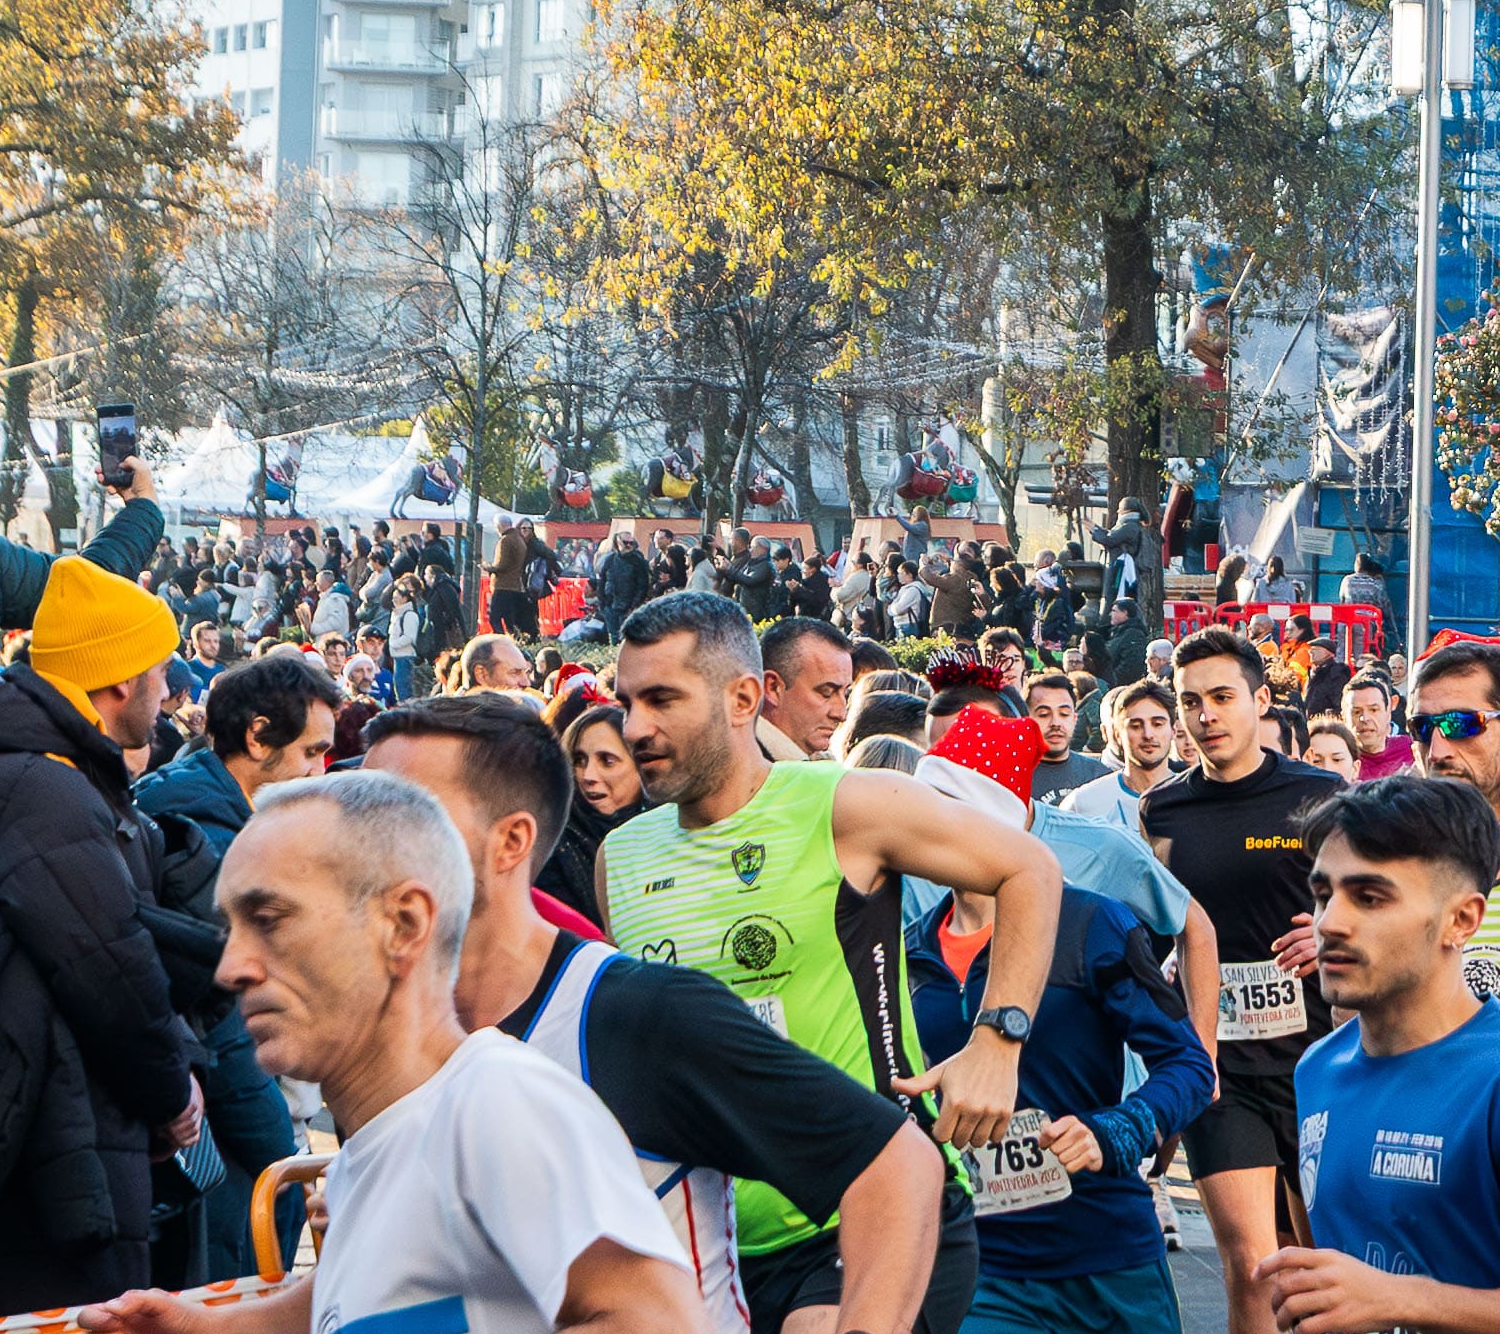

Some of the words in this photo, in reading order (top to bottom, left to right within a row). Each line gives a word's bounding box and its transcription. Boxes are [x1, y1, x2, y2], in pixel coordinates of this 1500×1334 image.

[1223, 967, 1245, 984] SAN
[1239, 978, 1296, 1011] 1553
[1240, 1009, 1284, 1026] PONTEVEDRA
[986, 1136, 1045, 1175] 763
[1373, 1150, 1382, 1175] A
[1382, 1152, 1435, 1182] CORUÑA
[986, 1171, 1039, 1196] PONTEVEDRA
[1040, 1166, 1062, 1184] 2025
